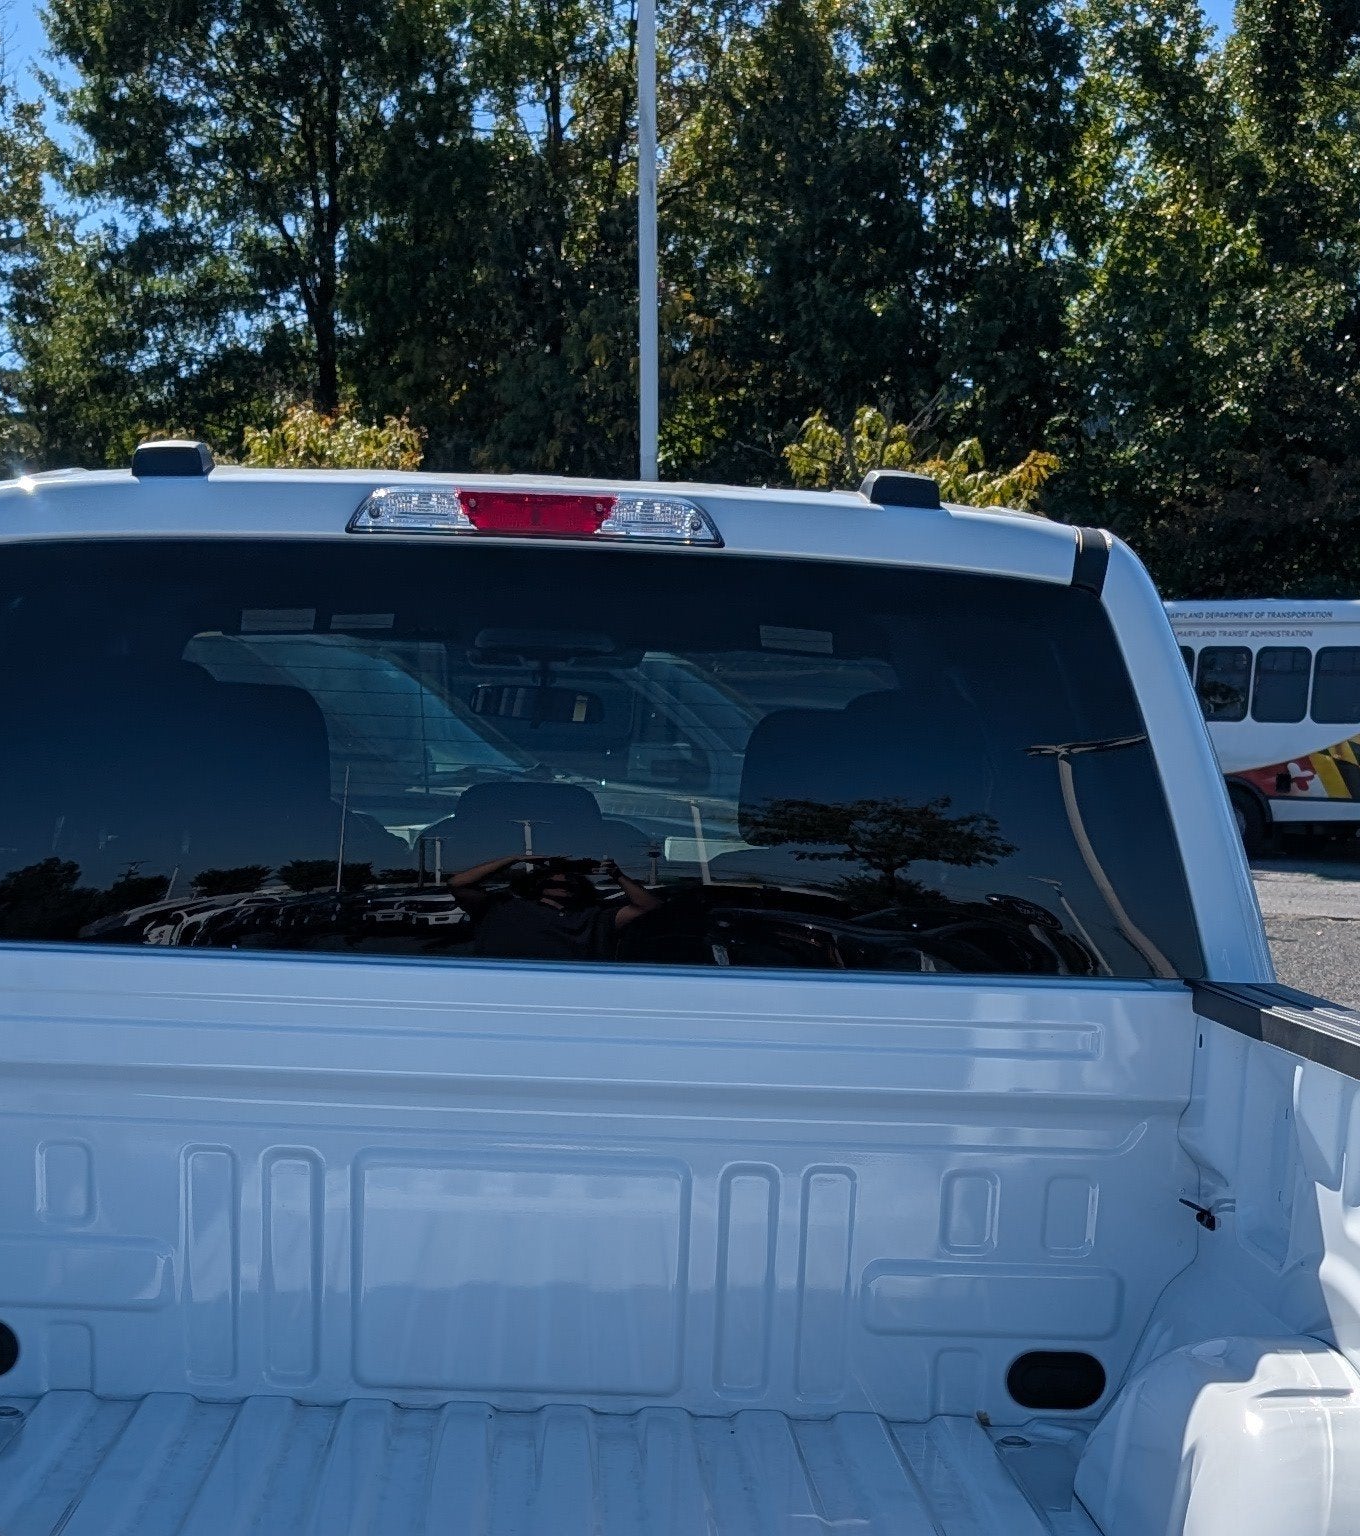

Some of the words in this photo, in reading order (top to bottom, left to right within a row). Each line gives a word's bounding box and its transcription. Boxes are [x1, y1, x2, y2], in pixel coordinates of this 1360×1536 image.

[1168, 611, 1204, 620] ARYLAND
[1205, 611, 1253, 620] DEPARTMENT
[1255, 611, 1265, 619] OF
[1267, 610, 1333, 619] TRANSPORTATION
